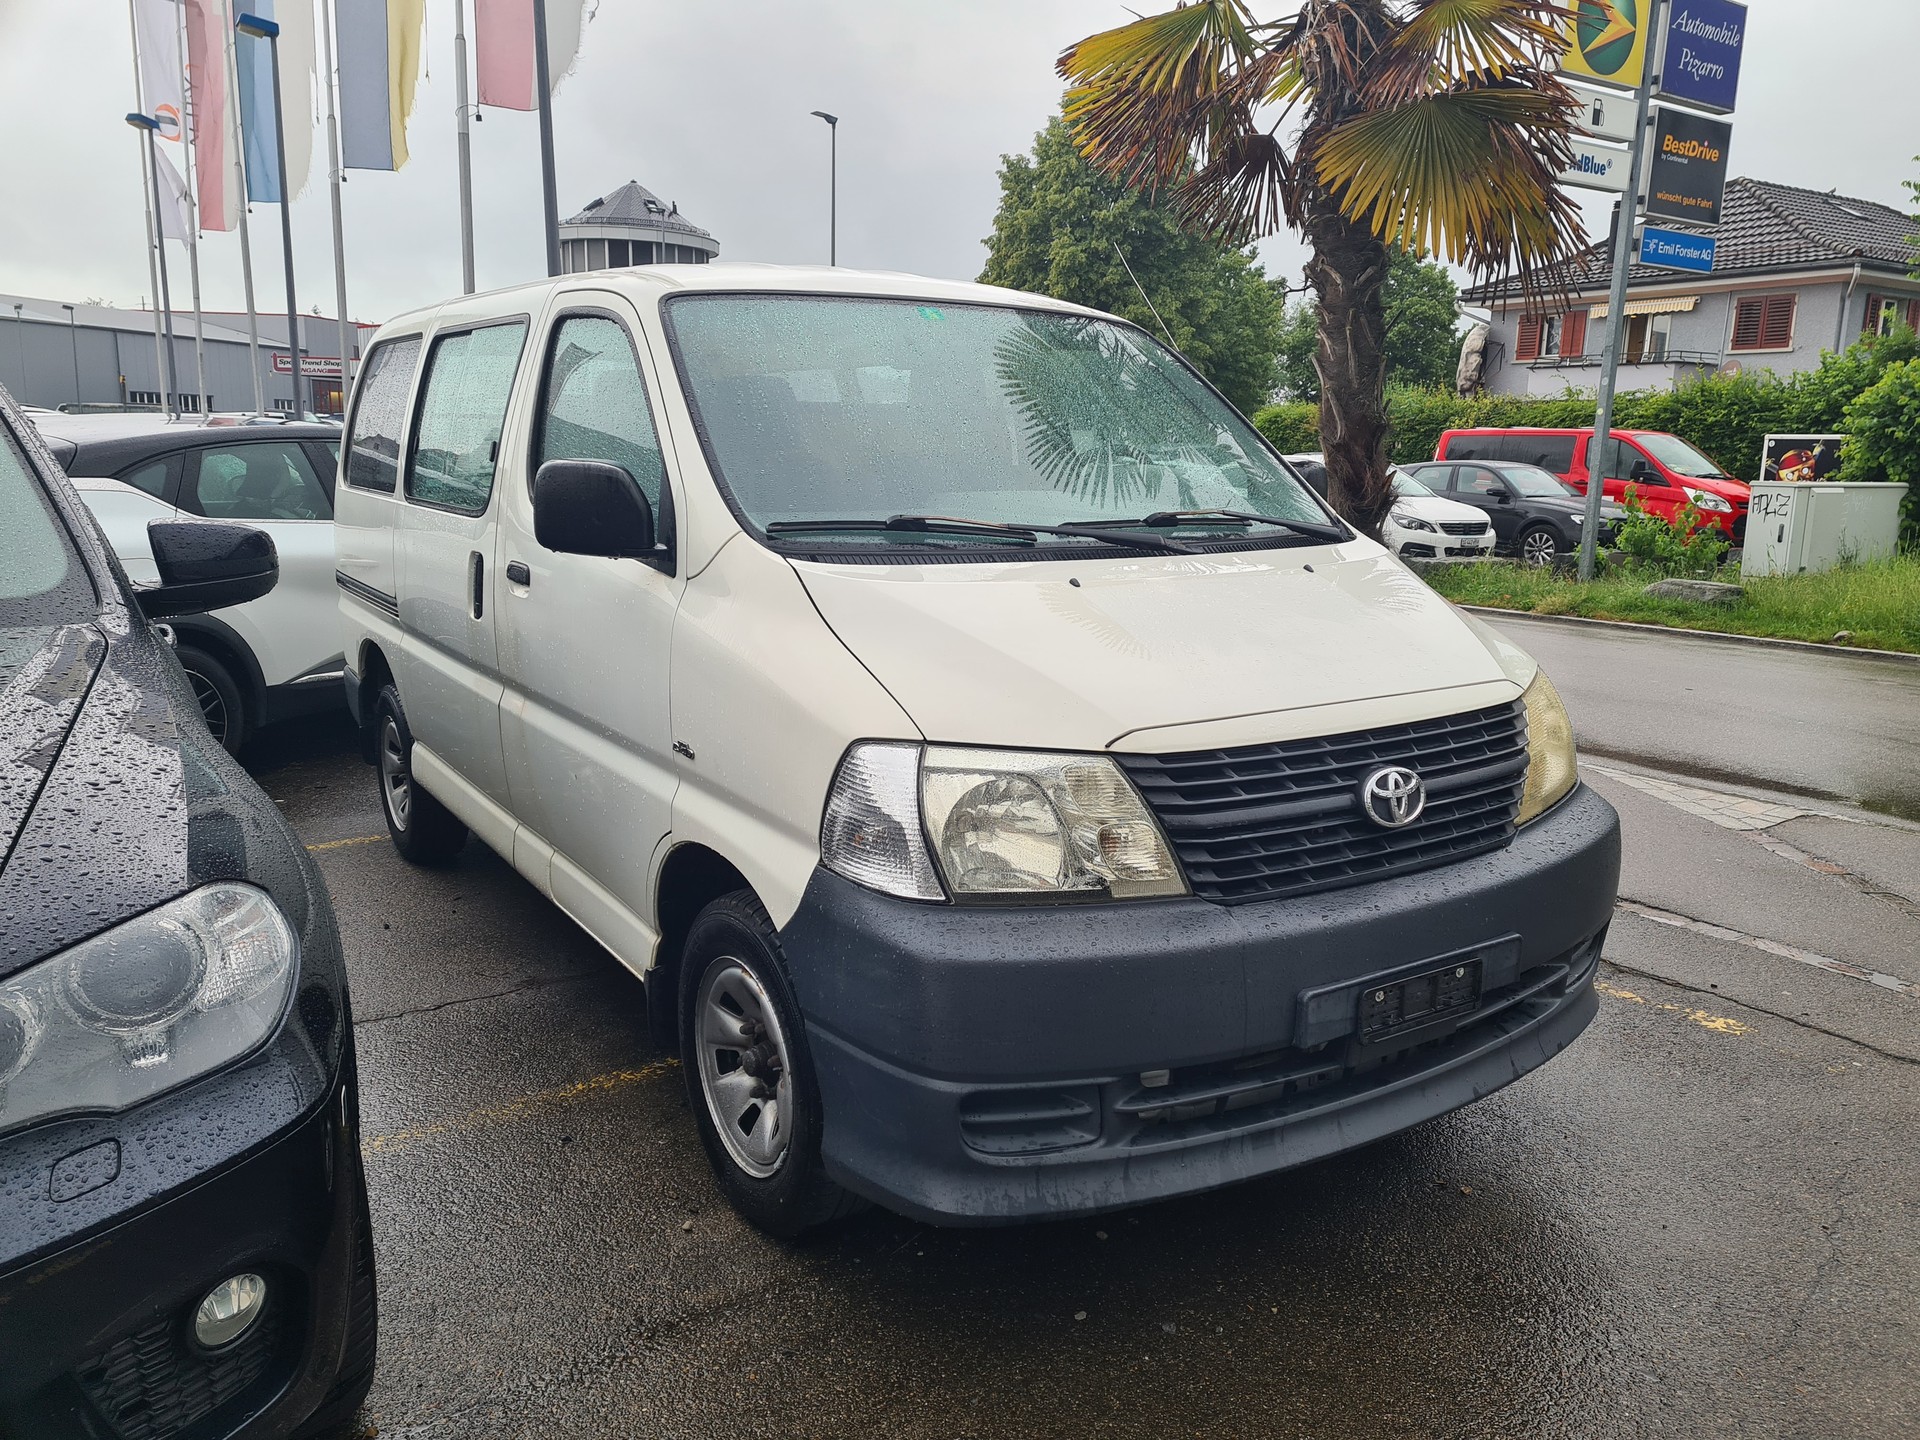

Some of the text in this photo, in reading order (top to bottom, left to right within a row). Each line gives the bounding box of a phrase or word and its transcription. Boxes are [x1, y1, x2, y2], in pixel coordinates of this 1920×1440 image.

[1671, 9, 1741, 47] Automobile
[1677, 47, 1724, 82] Pizarro
[1660, 153, 1689, 165] by Continental
[1662, 133, 1720, 162] BestDrive
[1656, 190, 1713, 209] wünscht gute Fahrt
[1657, 241, 1675, 256] Emil
[1674, 244, 1701, 259] Forster
[1700, 248, 1712, 261] AG
